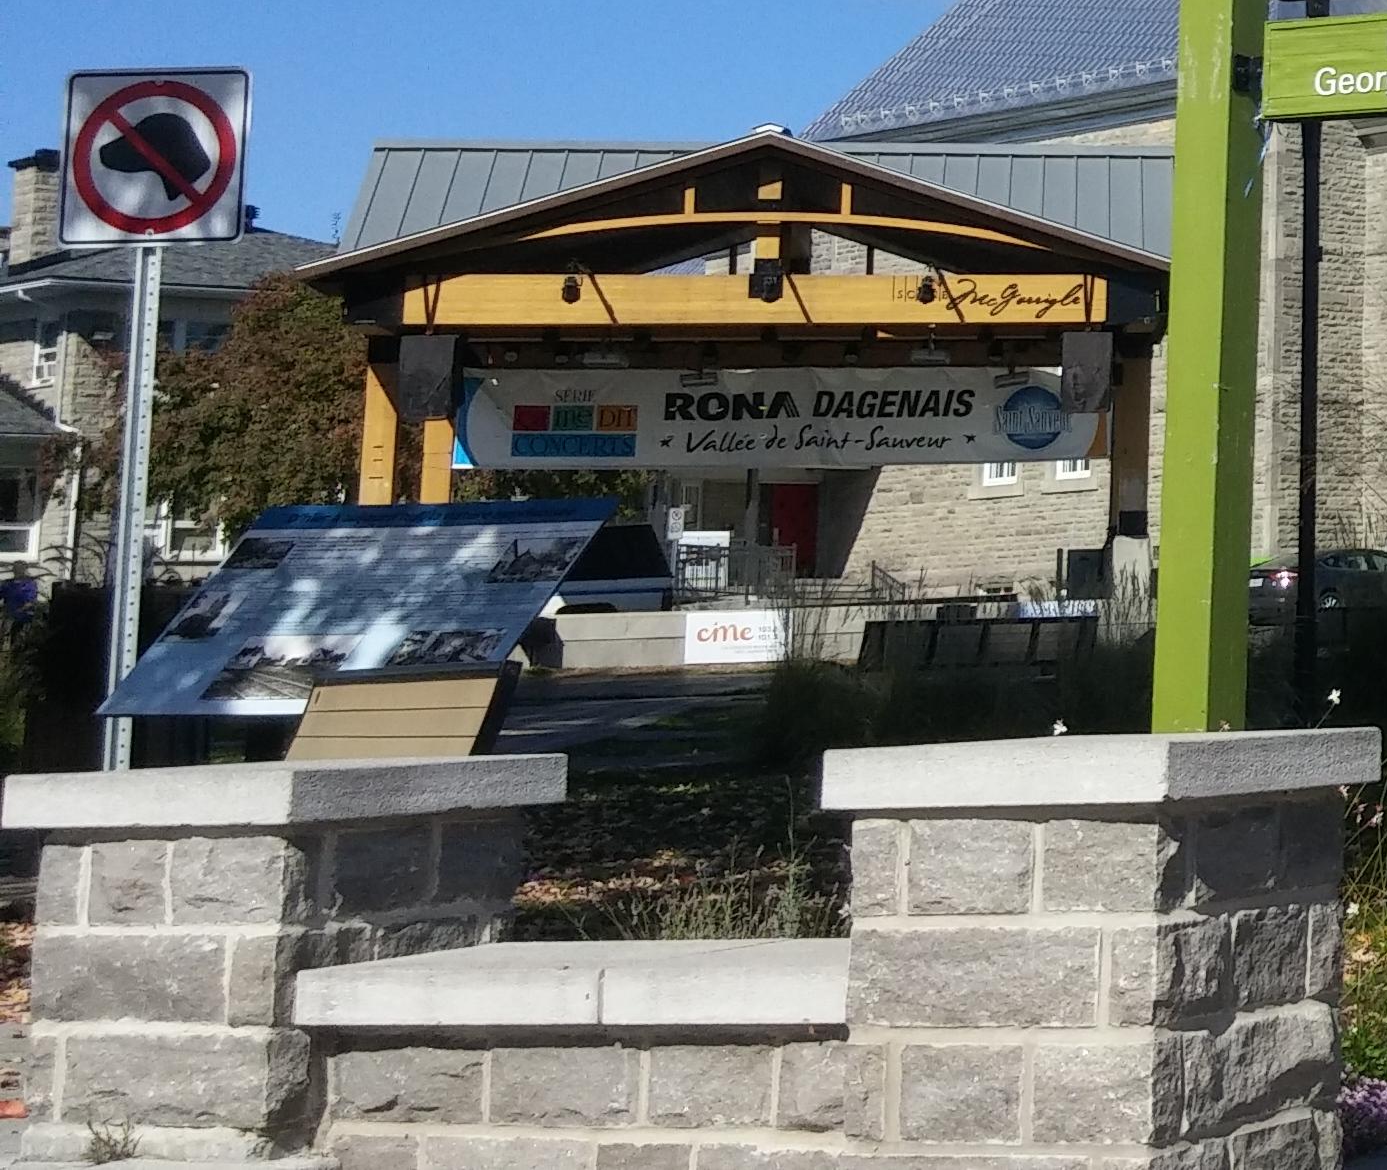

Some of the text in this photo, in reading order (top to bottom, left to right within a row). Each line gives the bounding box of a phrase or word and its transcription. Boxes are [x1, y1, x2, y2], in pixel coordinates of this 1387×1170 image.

[663, 389, 976, 421] RONA DAGENAIS
[515, 436, 634, 456] CONCERTS
[686, 424, 952, 453] Vallée de Saint-Sauveur
